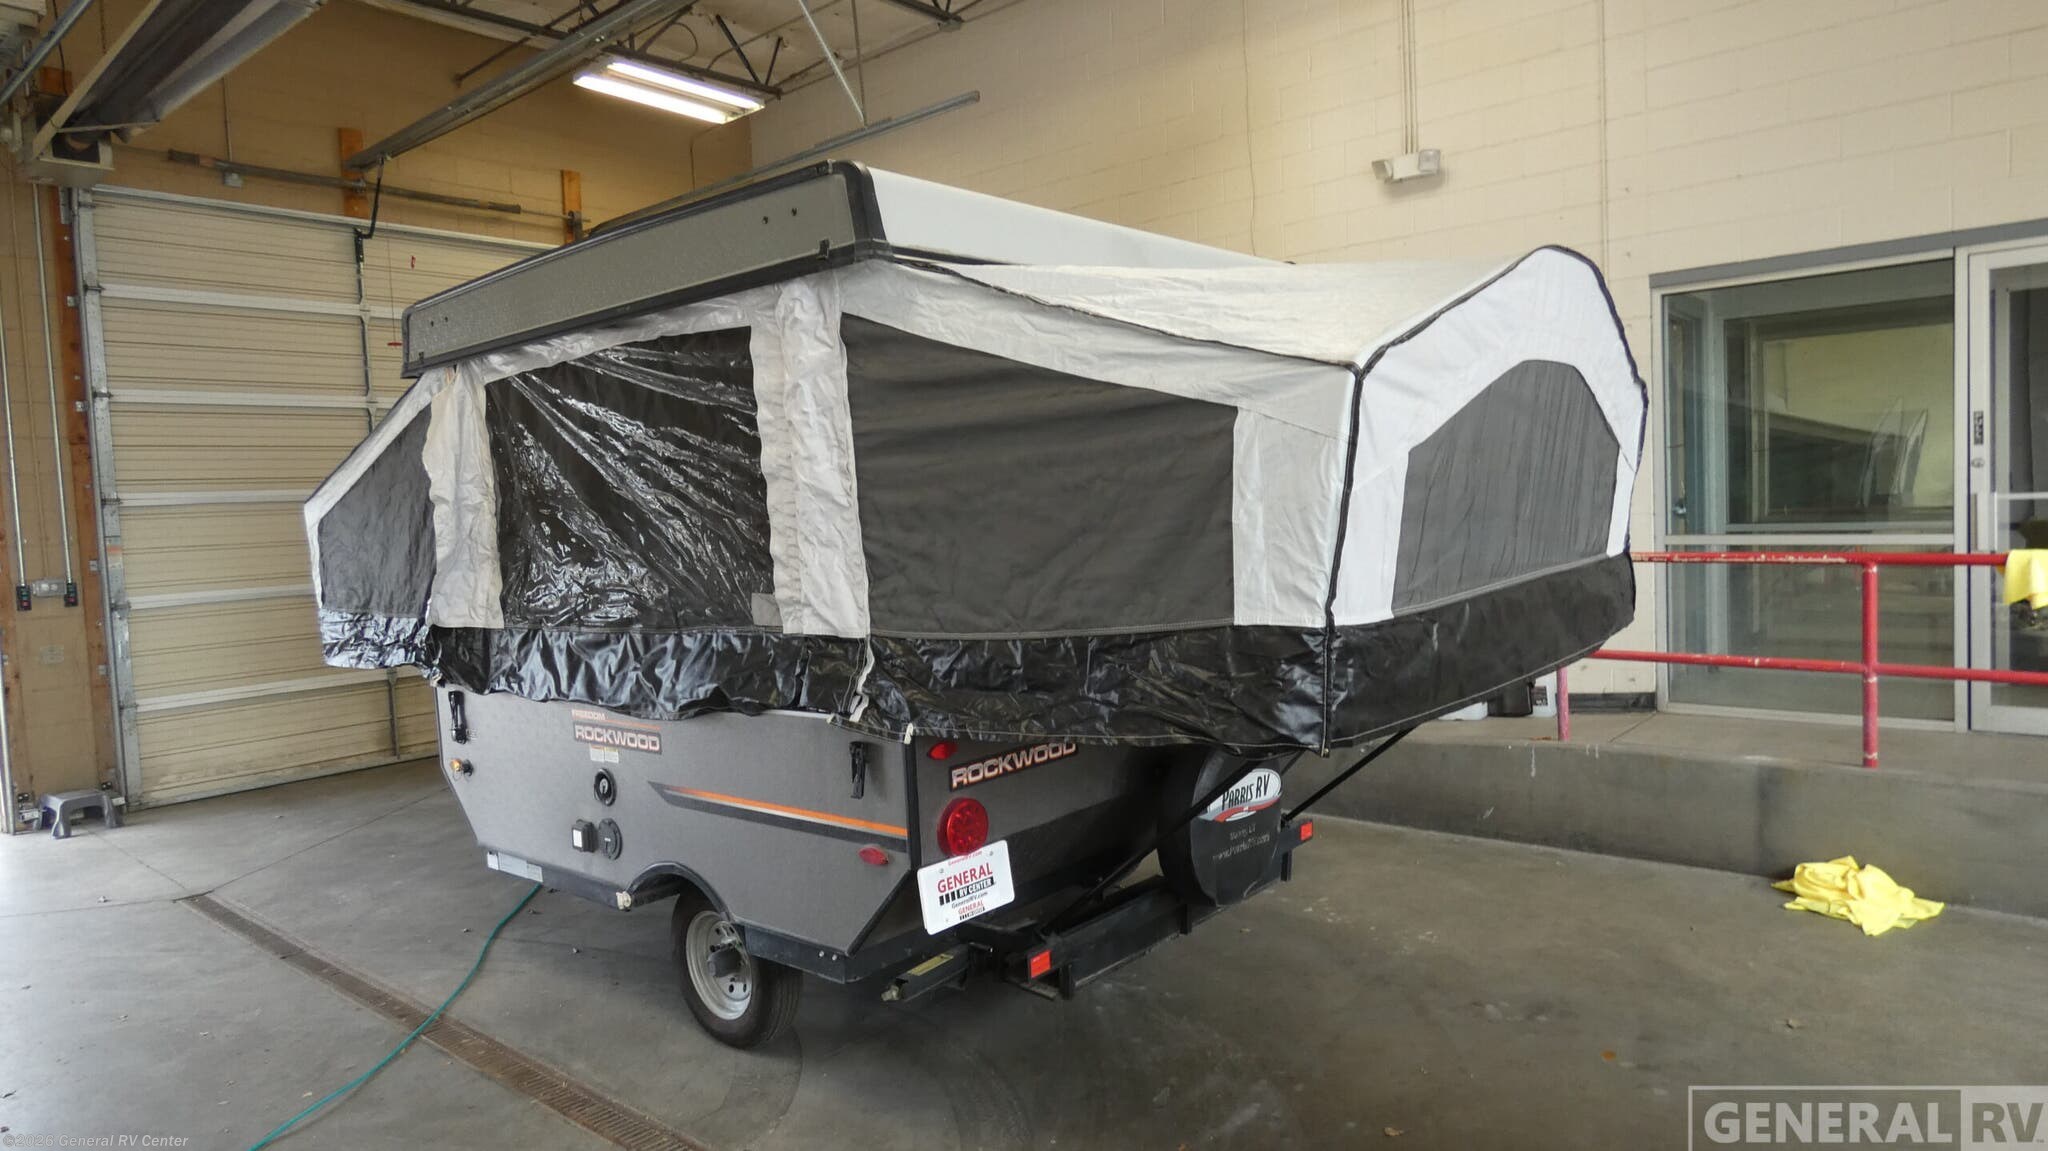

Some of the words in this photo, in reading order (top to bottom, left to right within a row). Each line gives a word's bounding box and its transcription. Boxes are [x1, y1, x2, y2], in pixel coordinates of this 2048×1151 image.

[574, 724, 660, 751] ROCKWOOD
[951, 742, 1077, 789] ROCKWOOD
[1221, 784, 1255, 811] PARRIS
[1255, 774, 1271, 799] RV
[937, 862, 993, 893] GENERAL
[959, 887, 968, 898] RV
[968, 878, 992, 894] CENTER
[958, 900, 984, 915] GENERAL
